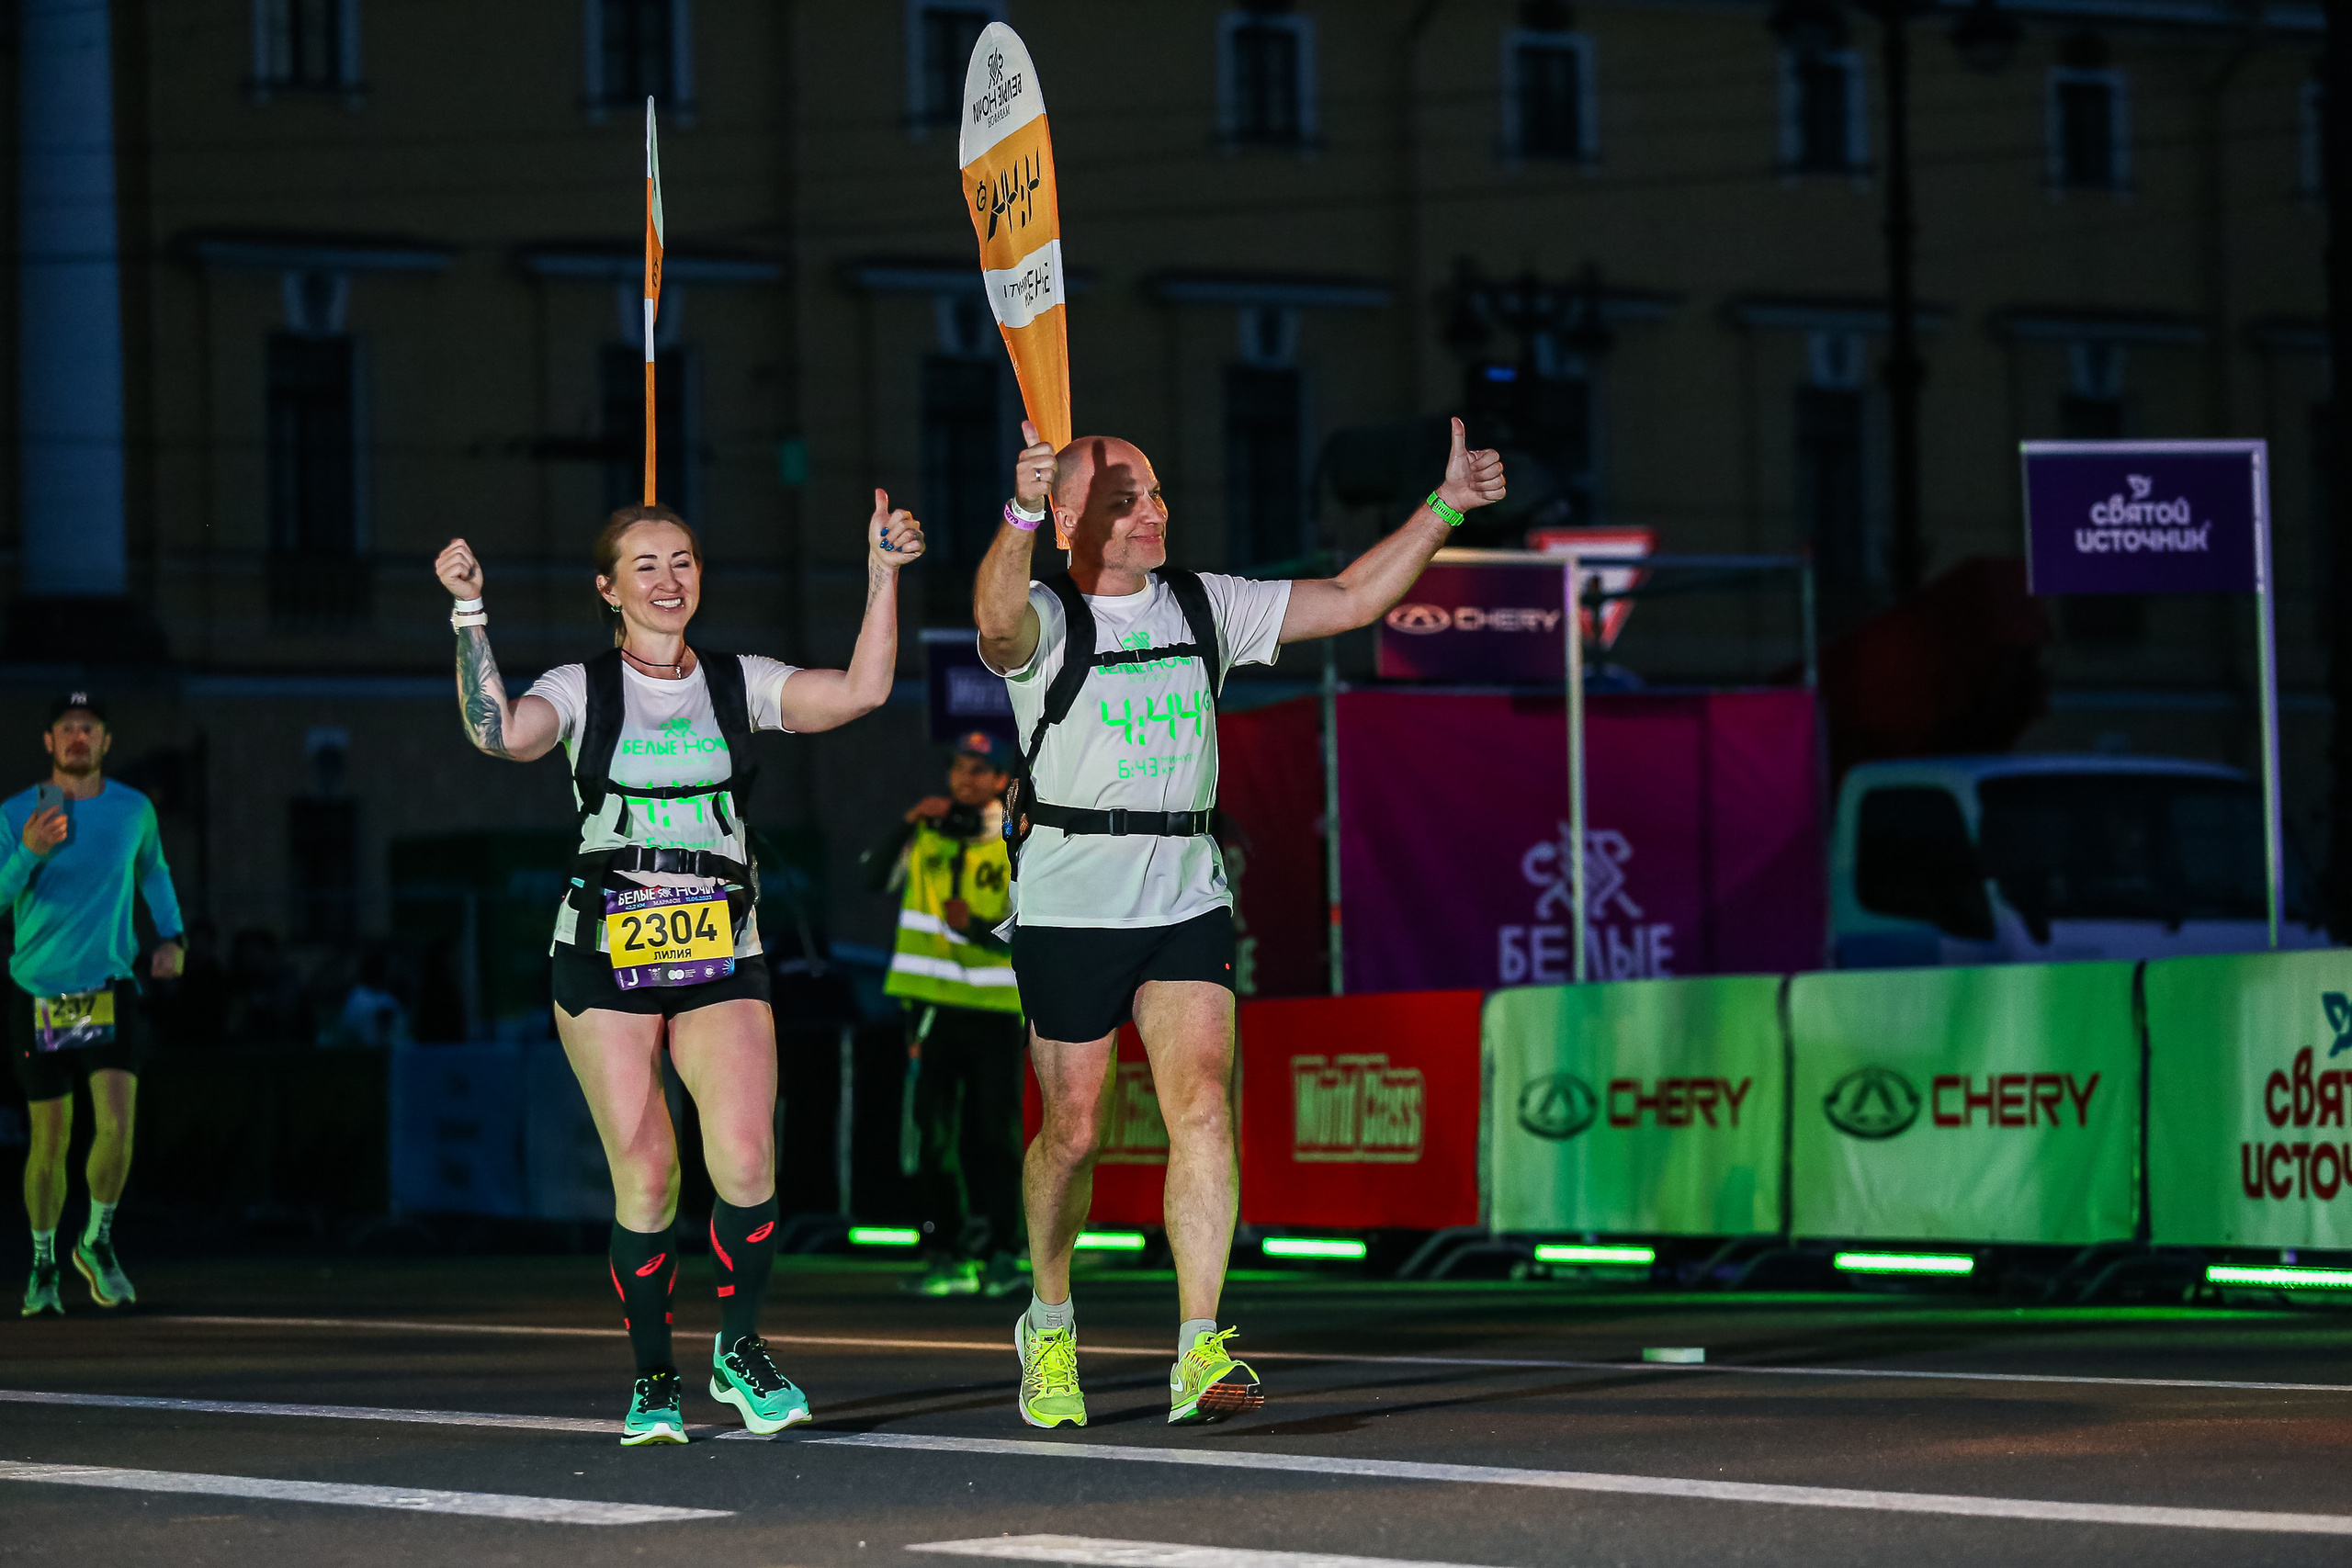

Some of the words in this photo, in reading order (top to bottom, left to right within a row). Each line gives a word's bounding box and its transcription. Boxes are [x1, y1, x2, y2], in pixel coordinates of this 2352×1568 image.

[1454, 606, 1561, 633] CHERY
[1101, 691, 1202, 745] 4:44
[623, 739, 678, 755] БЕЛЫЕ
[1118, 757, 1158, 779] 6:43
[618, 888, 656, 906] БЕЛЫЕ
[621, 908, 718, 951] 2304
[654, 948, 692, 960] ЛИЛИЯ
[1608, 1077, 1753, 1130] CHERY
[1931, 1072, 2100, 1129] CHERY
